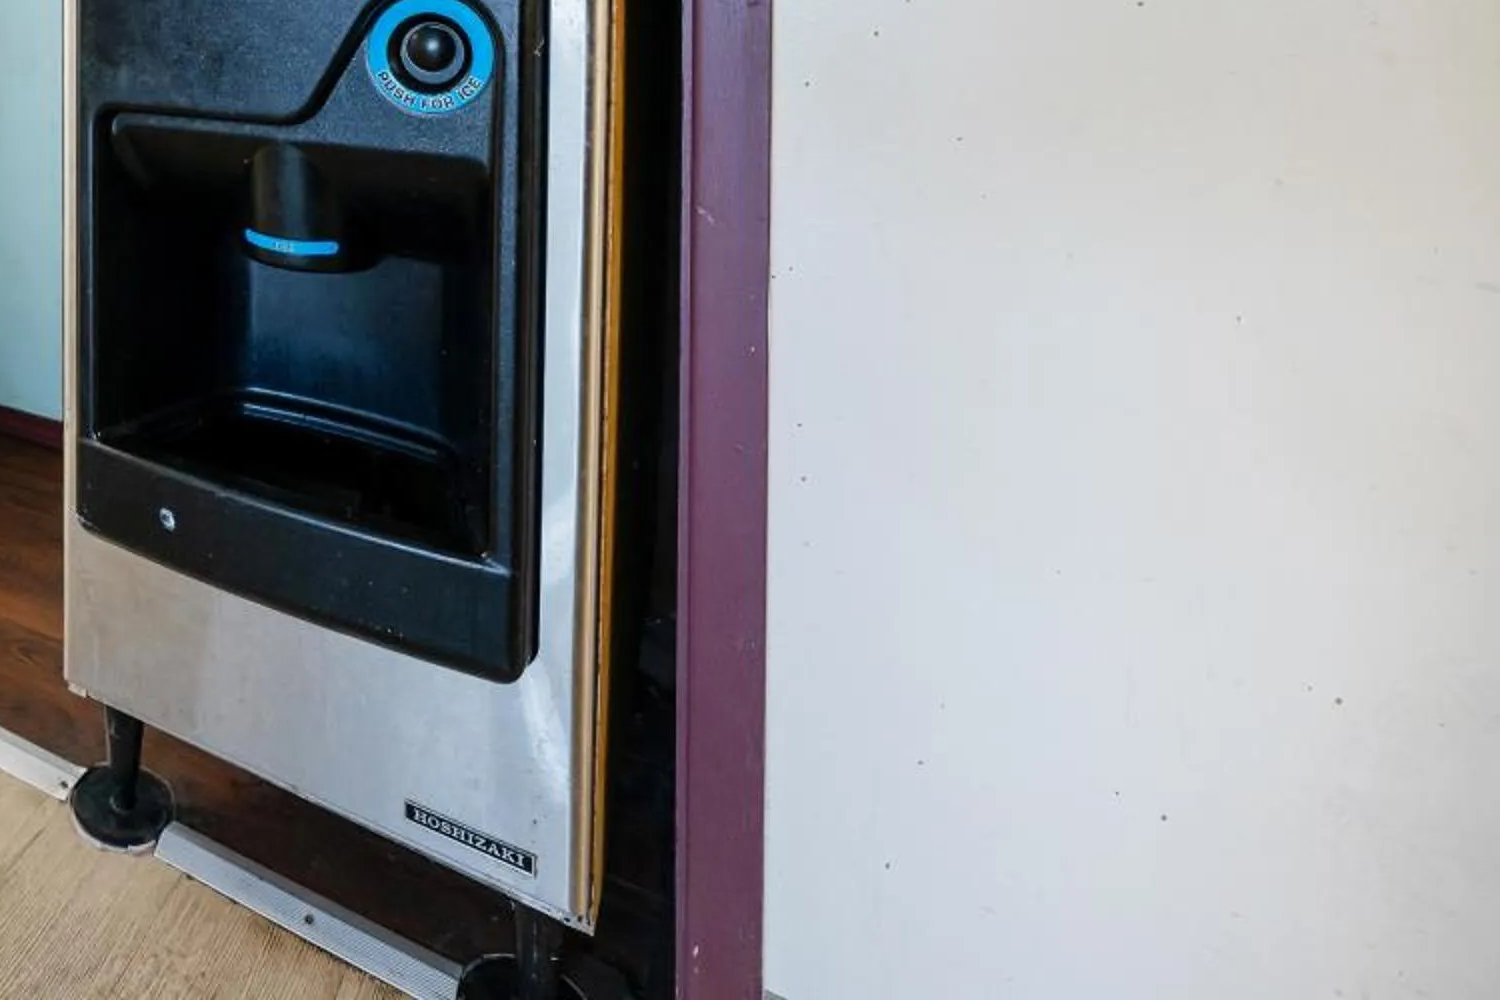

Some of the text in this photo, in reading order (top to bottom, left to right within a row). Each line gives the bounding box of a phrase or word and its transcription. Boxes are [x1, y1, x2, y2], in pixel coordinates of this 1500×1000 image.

[377, 70, 483, 109] PUSH FOR ICE
[413, 806, 526, 868] HOSHIZAKI
